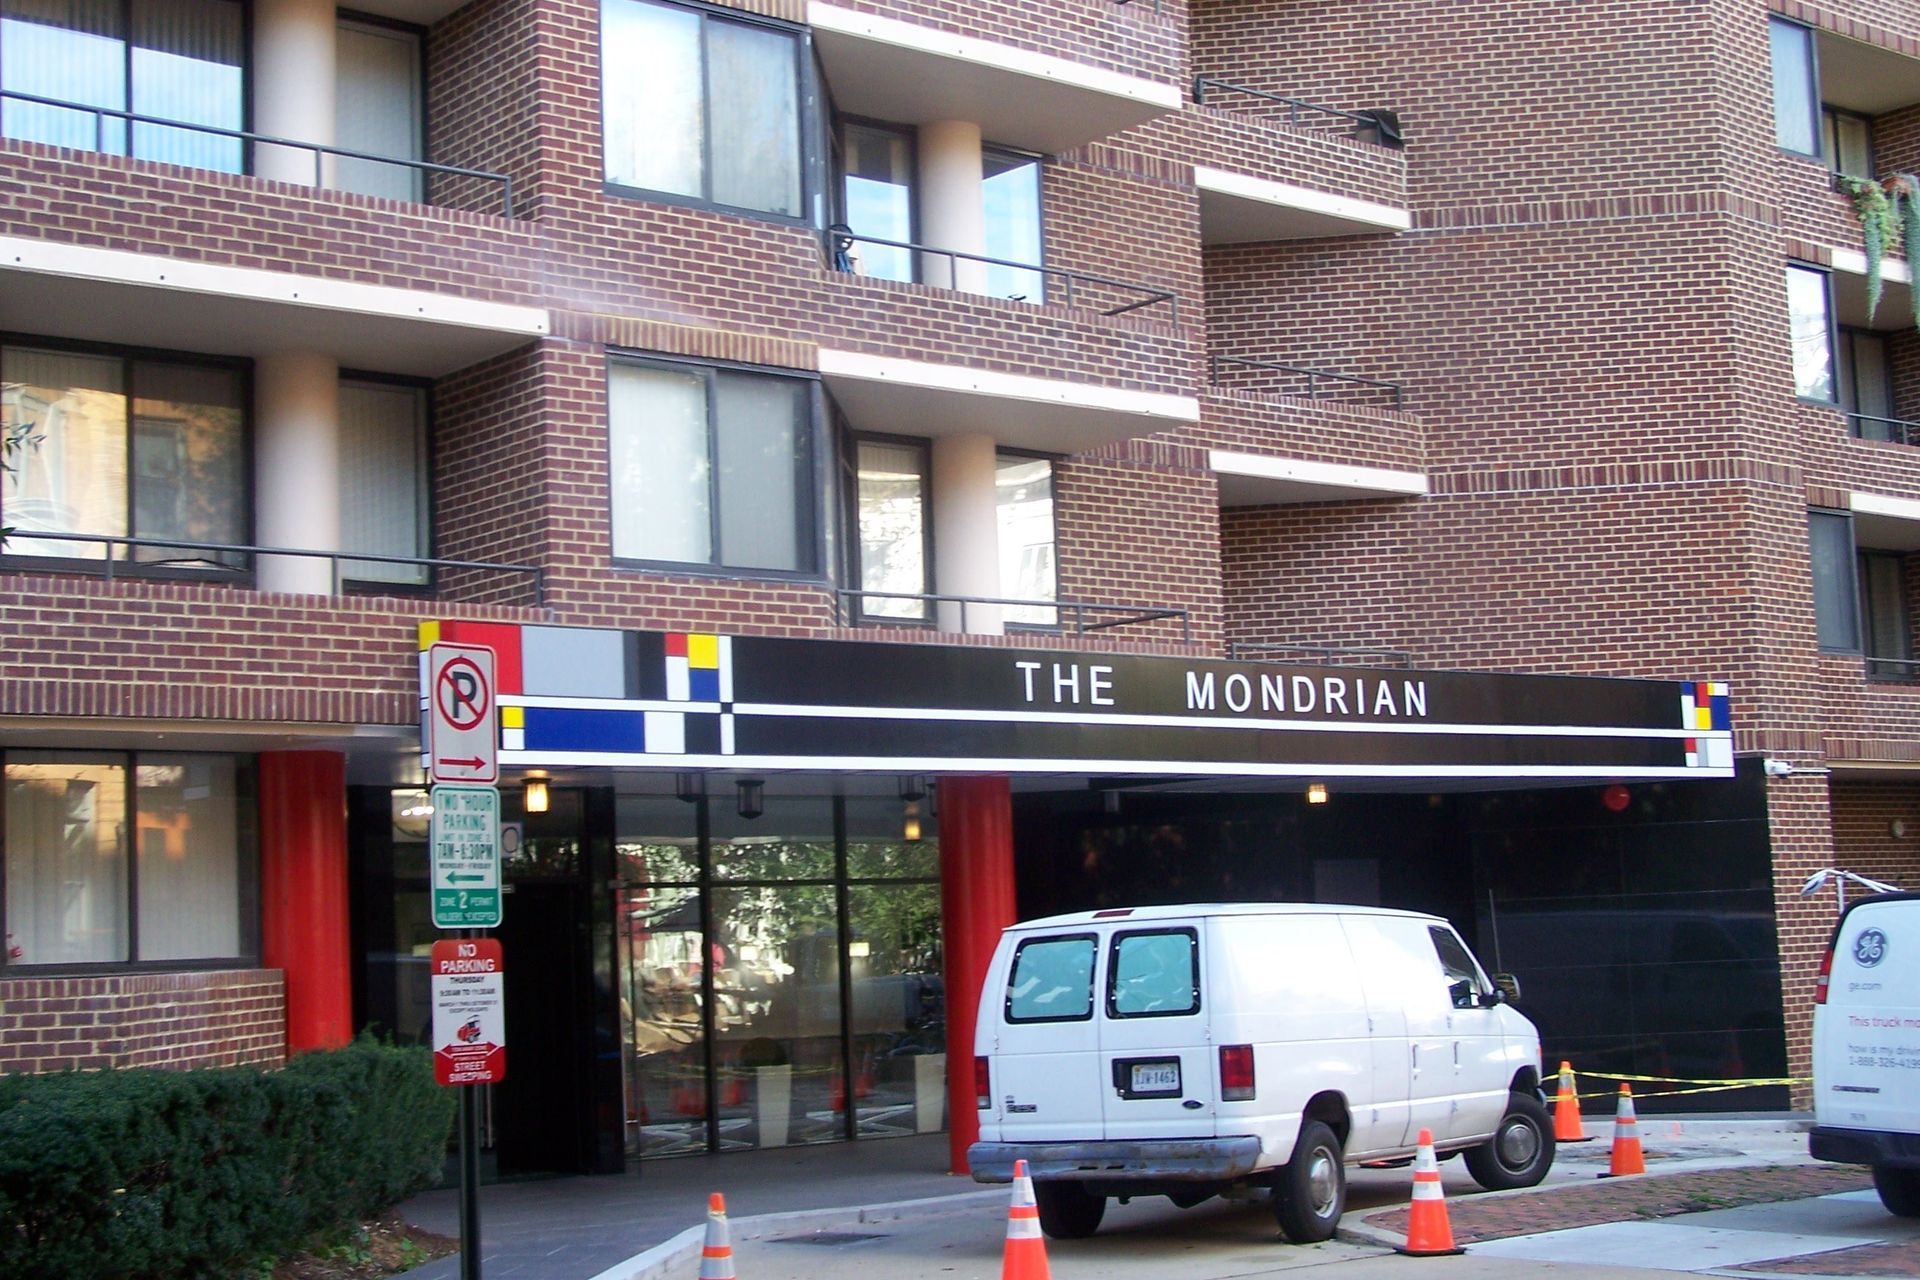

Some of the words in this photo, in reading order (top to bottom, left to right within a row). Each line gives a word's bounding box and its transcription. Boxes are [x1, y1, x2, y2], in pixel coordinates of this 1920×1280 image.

[1015, 661, 1115, 706] THE
[1186, 671, 1427, 716] MONDRIAN
[438, 793, 458, 811] TWO
[465, 794, 493, 812] HOUR
[443, 813, 486, 832] PARKING
[459, 891, 468, 909] 2
[457, 943, 477, 957] NO
[440, 958, 495, 974] PARKING
[449, 976, 485, 985] THURSDAY
[1848, 1014, 1869, 1028] This
[1872, 1017, 1900, 1028] truck
[454, 1060, 486, 1072] STREET
[448, 1070, 493, 1083] SWEEPING
